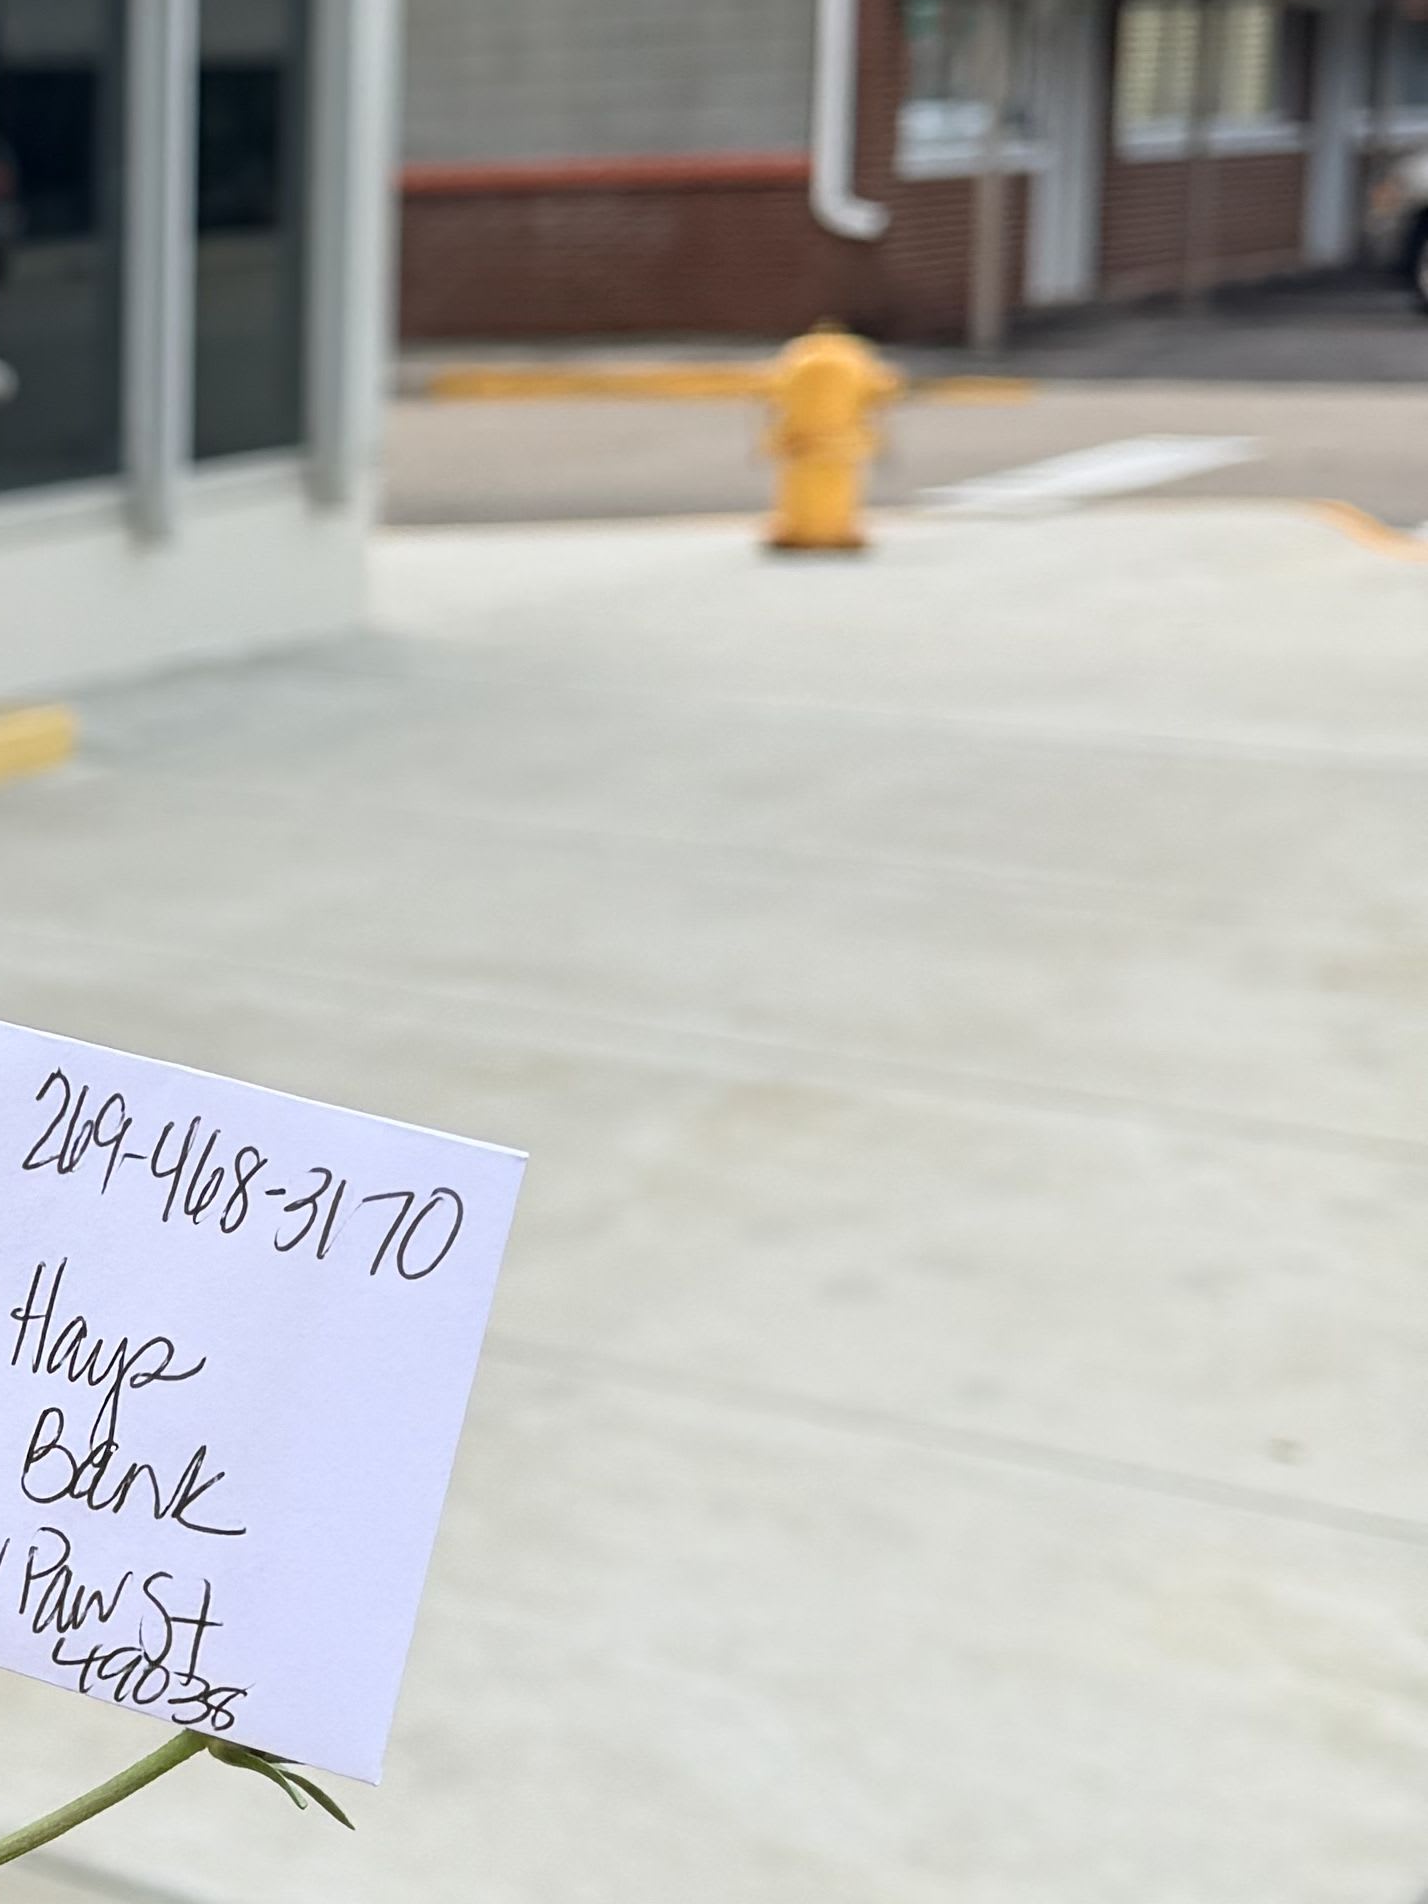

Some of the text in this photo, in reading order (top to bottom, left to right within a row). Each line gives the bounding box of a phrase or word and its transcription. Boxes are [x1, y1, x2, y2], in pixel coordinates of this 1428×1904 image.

[21, 1066, 465, 1280] 269-468-3170
[20, 1407, 247, 1535] Bank
[18, 1526, 134, 1634] Paw
[140, 1571, 224, 1687] St
[51, 1636, 249, 1732] 49038
